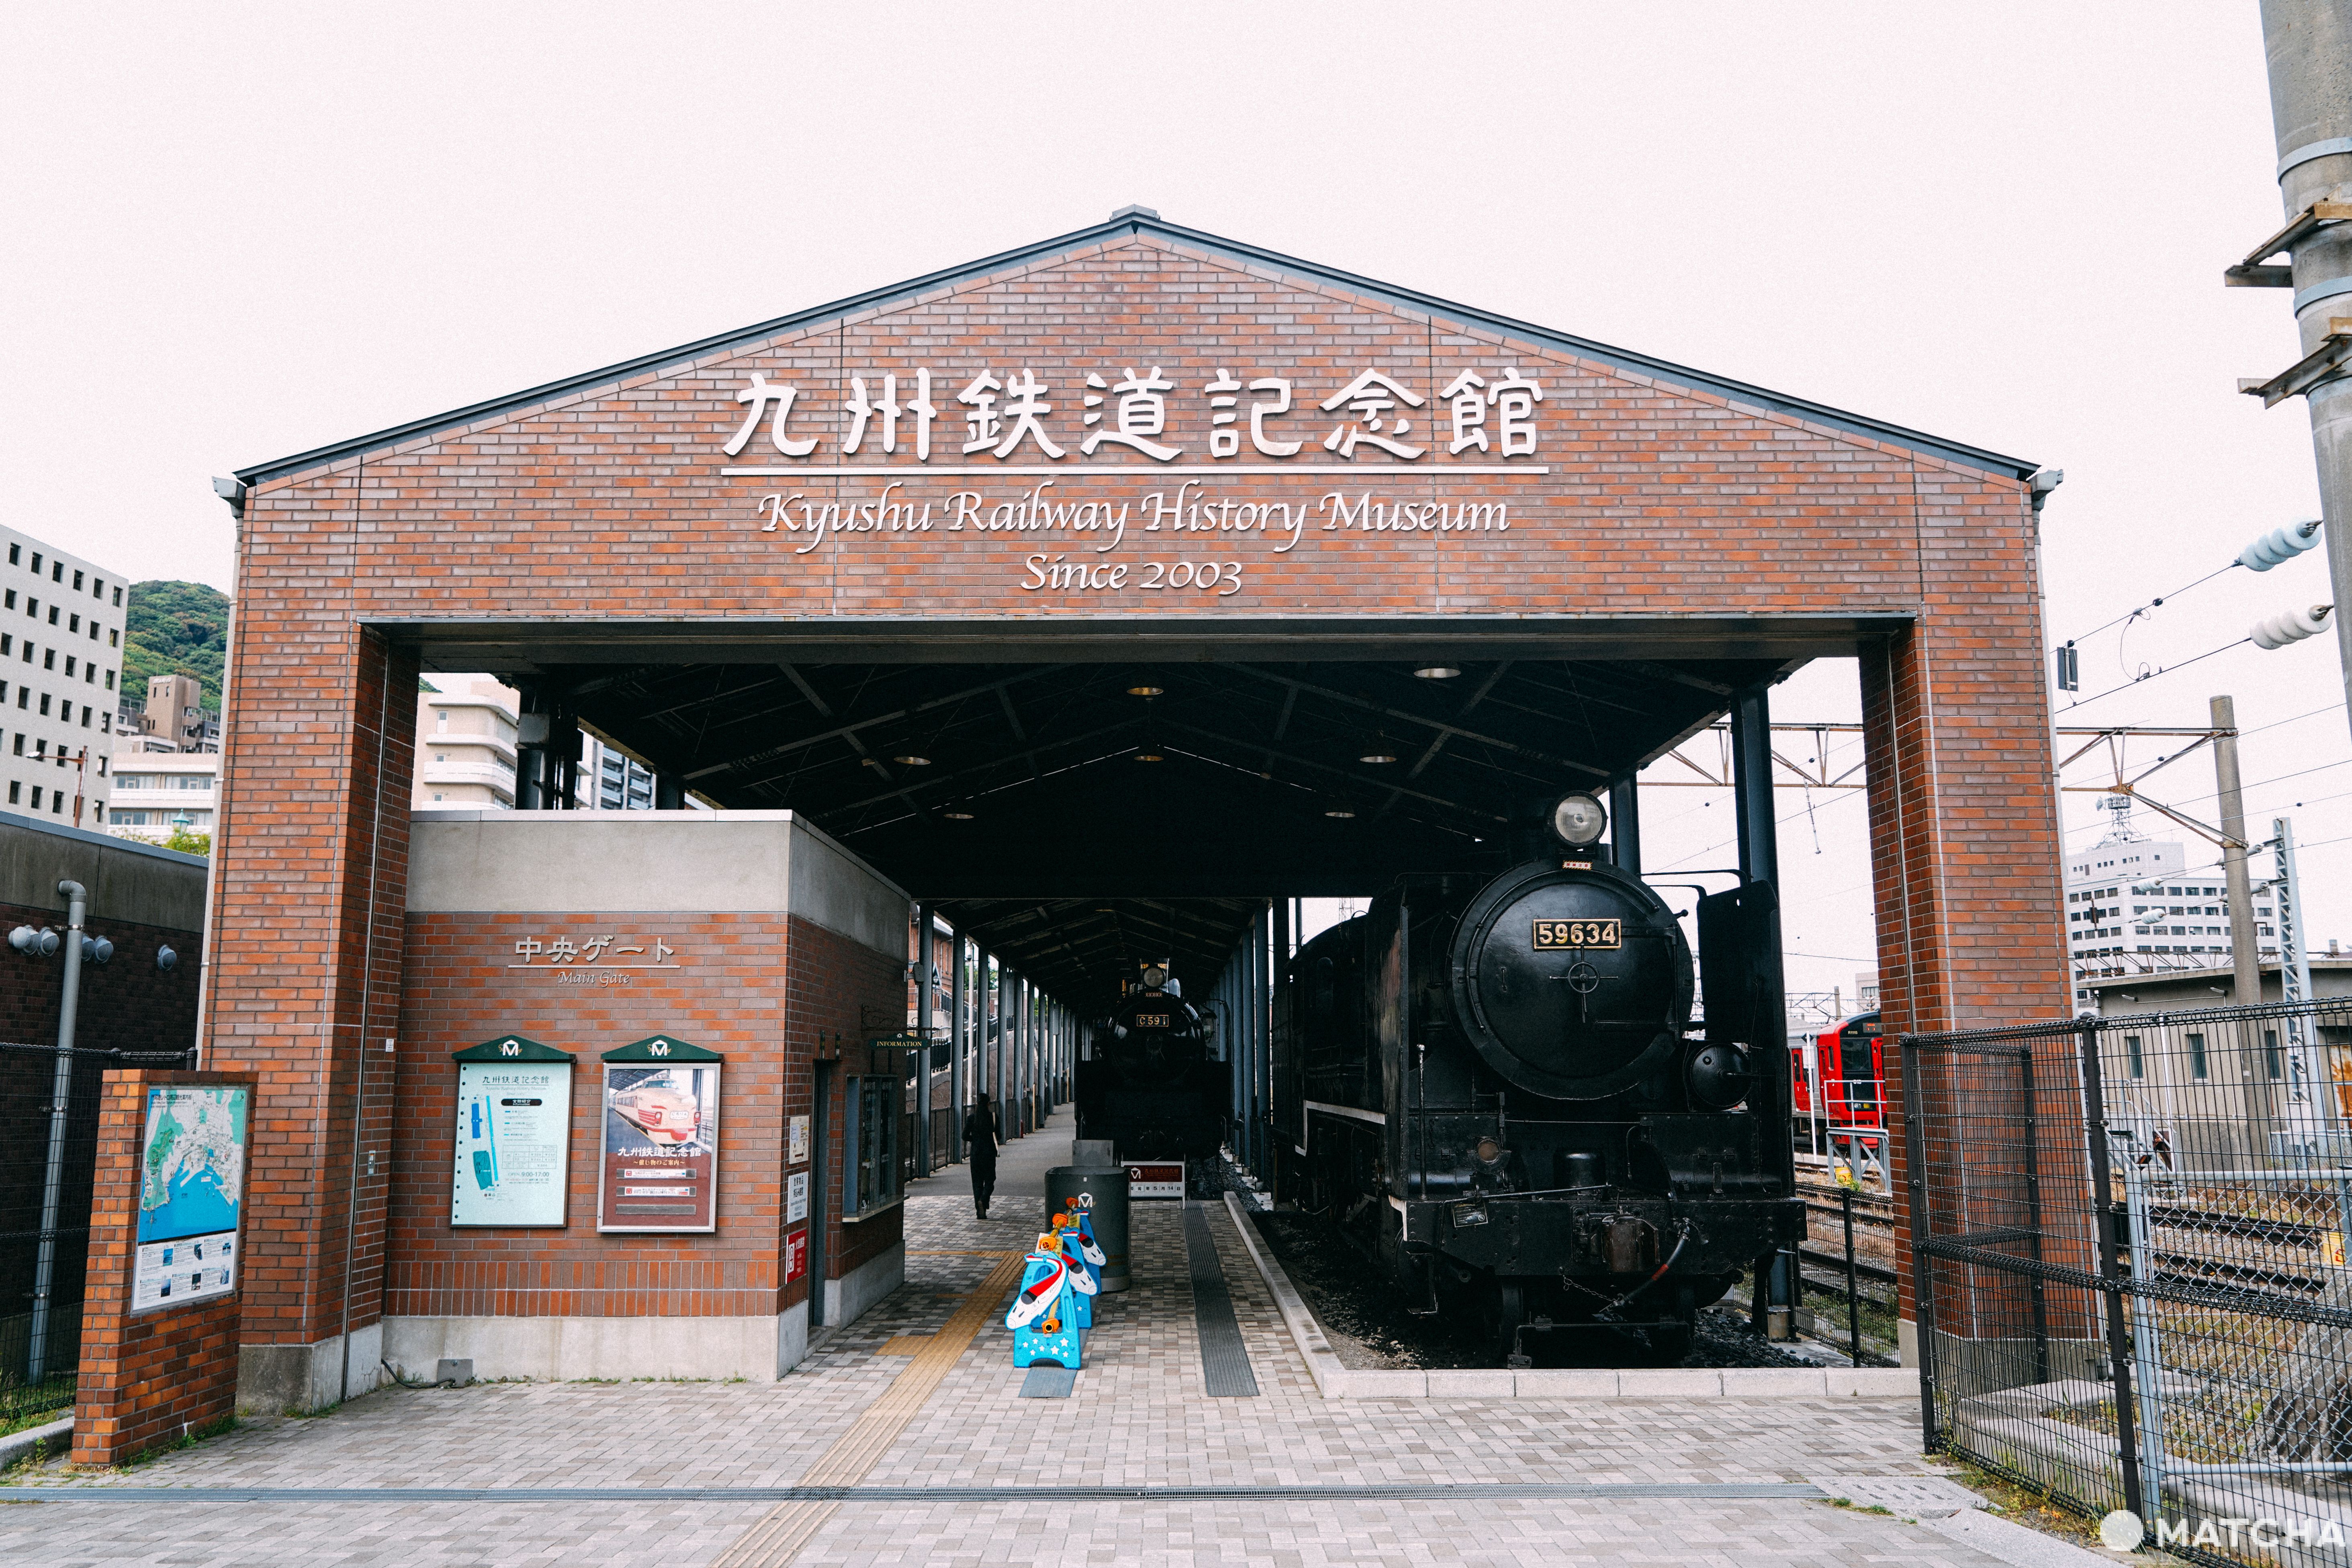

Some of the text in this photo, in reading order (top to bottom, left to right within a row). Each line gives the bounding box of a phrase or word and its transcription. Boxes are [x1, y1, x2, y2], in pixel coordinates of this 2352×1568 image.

[722, 366, 1543, 460] 九州鉄道記念館
[758, 479, 1510, 554] Kyushu Railway History Museum
[1020, 554, 1242, 596] Since 2003
[1539, 923, 1616, 944] 59634
[515, 934, 674, 963] 中央ゲート
[557, 971, 630, 987] Main Gate
[482, 1075, 550, 1084] 九州鉄道記念館
[617, 1147, 702, 1157] 九州鉄道記念館
